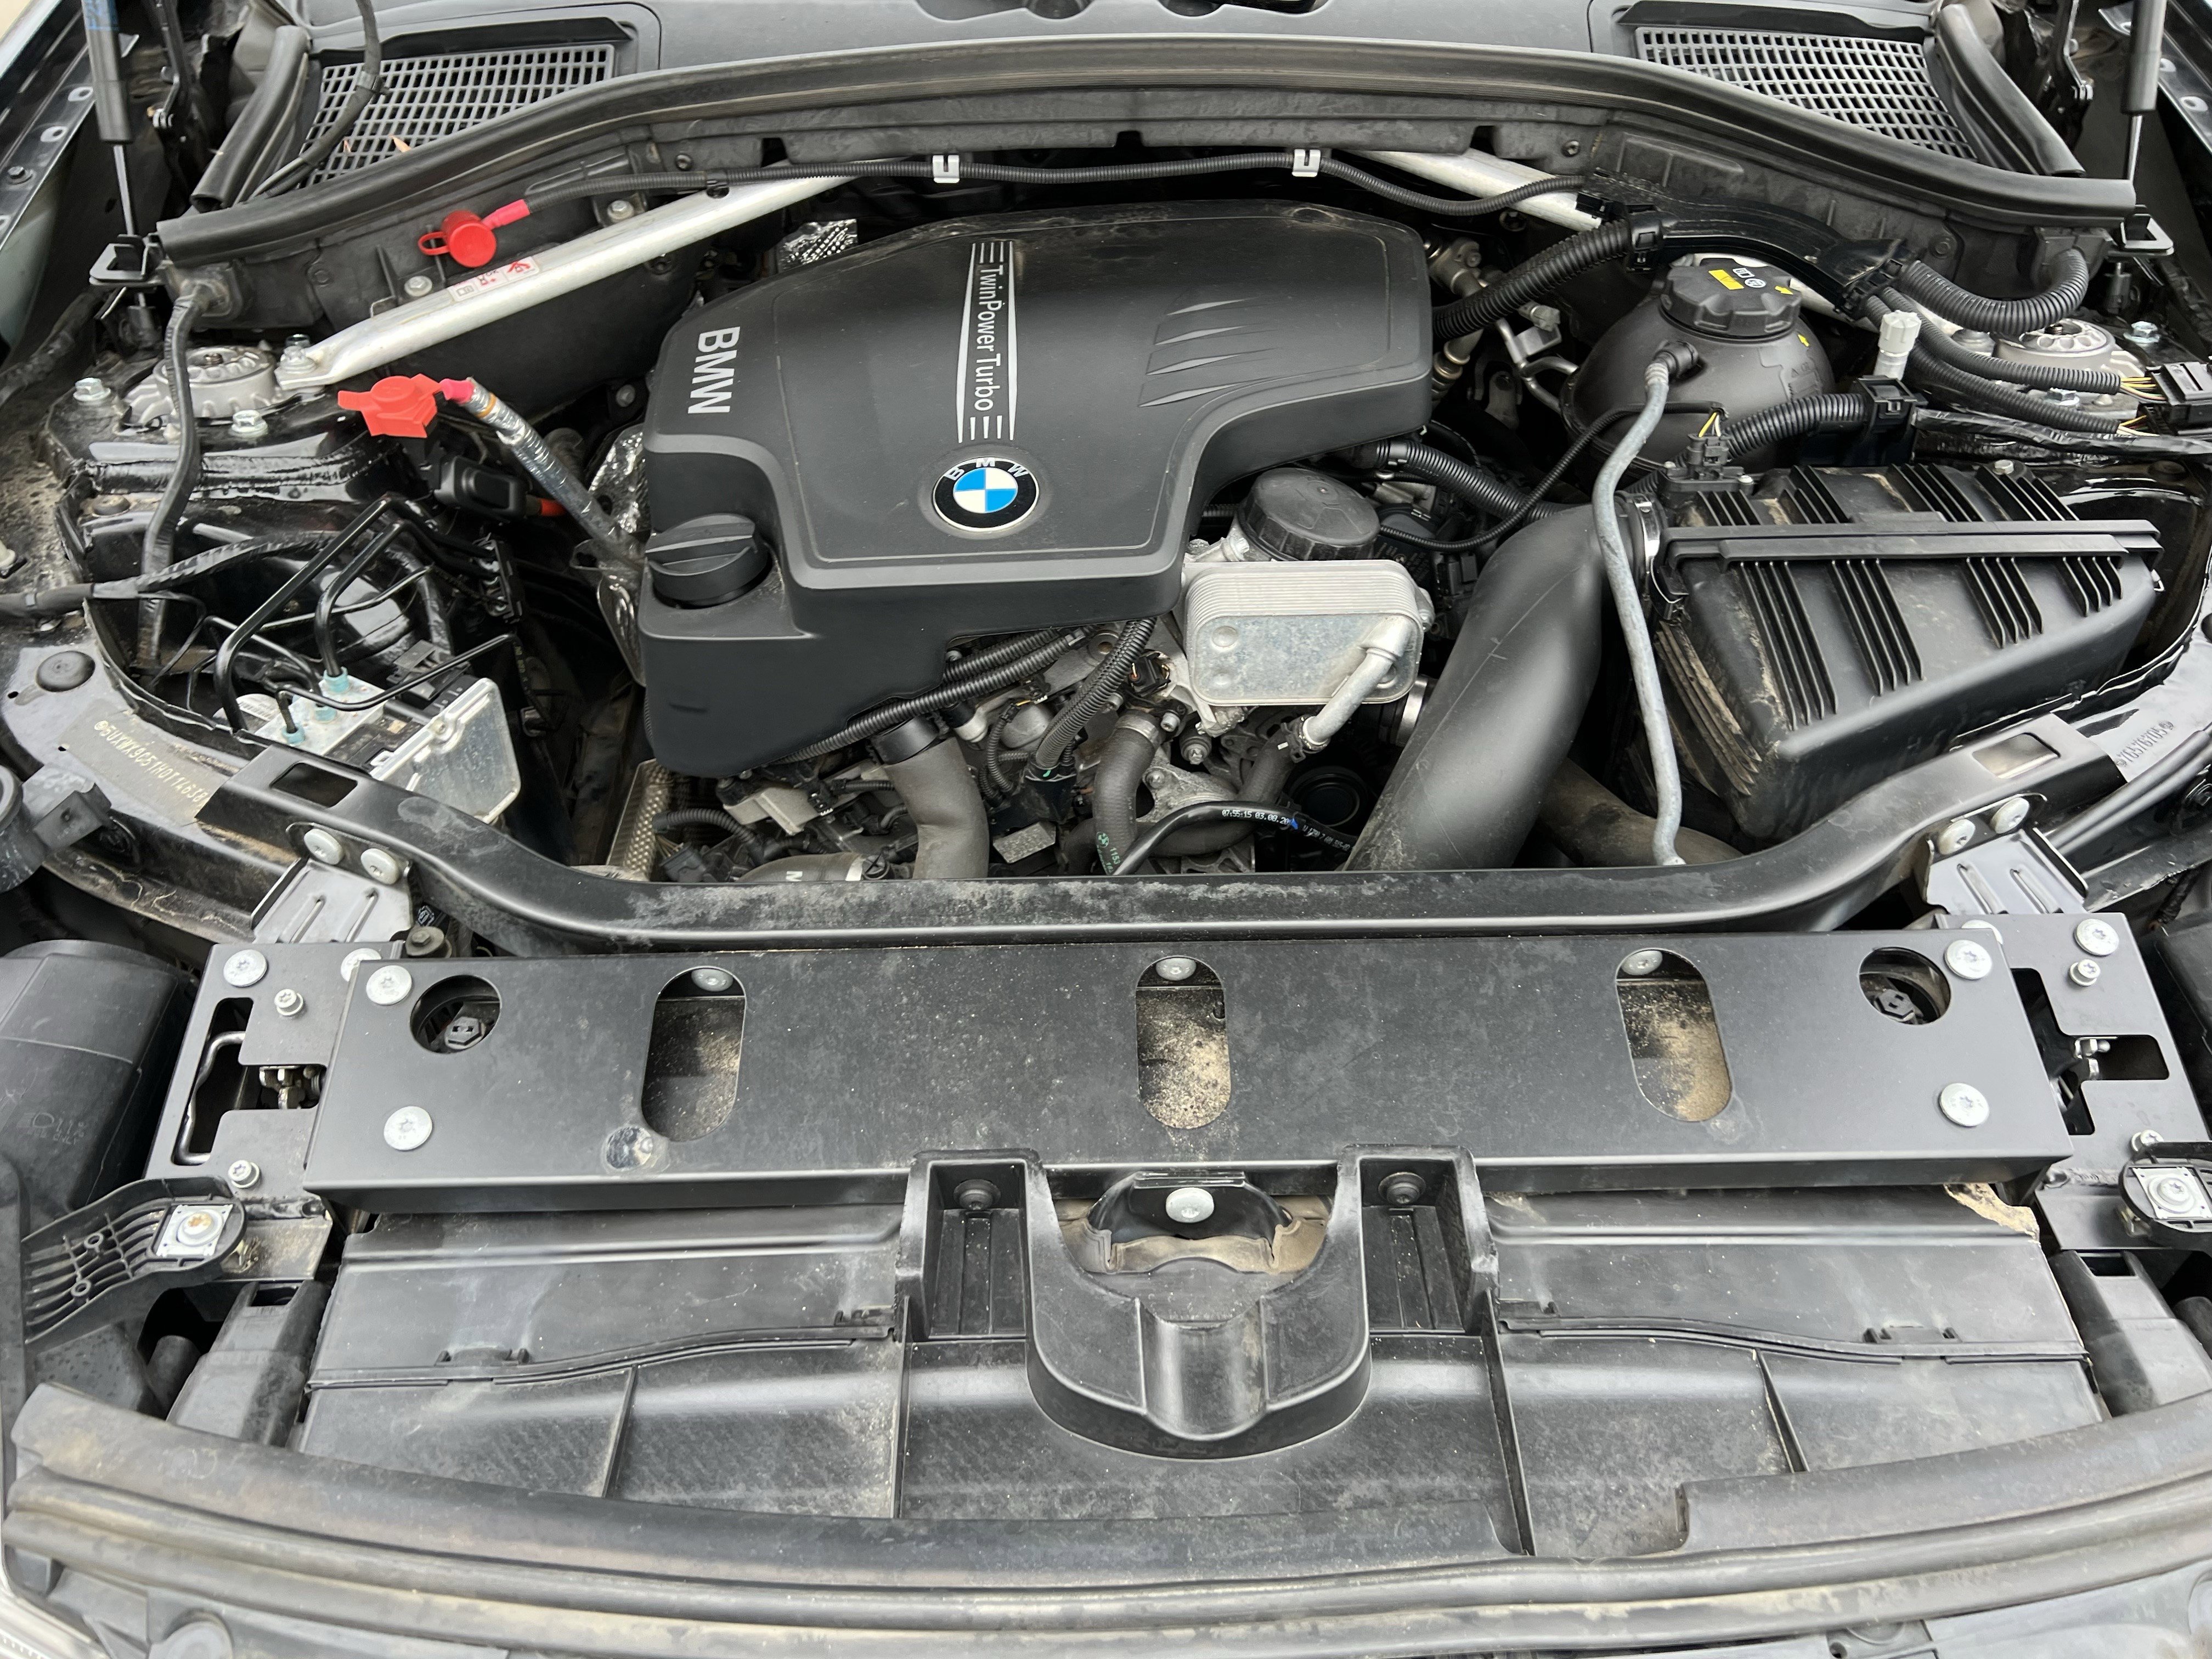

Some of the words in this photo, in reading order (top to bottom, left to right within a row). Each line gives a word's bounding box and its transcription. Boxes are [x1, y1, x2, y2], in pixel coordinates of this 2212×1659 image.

[976, 264, 1005, 352] TwinPower
[687, 326, 741, 414] BMW
[974, 353, 1001, 411] Turbo
[944, 457, 1030, 481] BMW
[1221, 809, 1252, 819] 07:55:15
